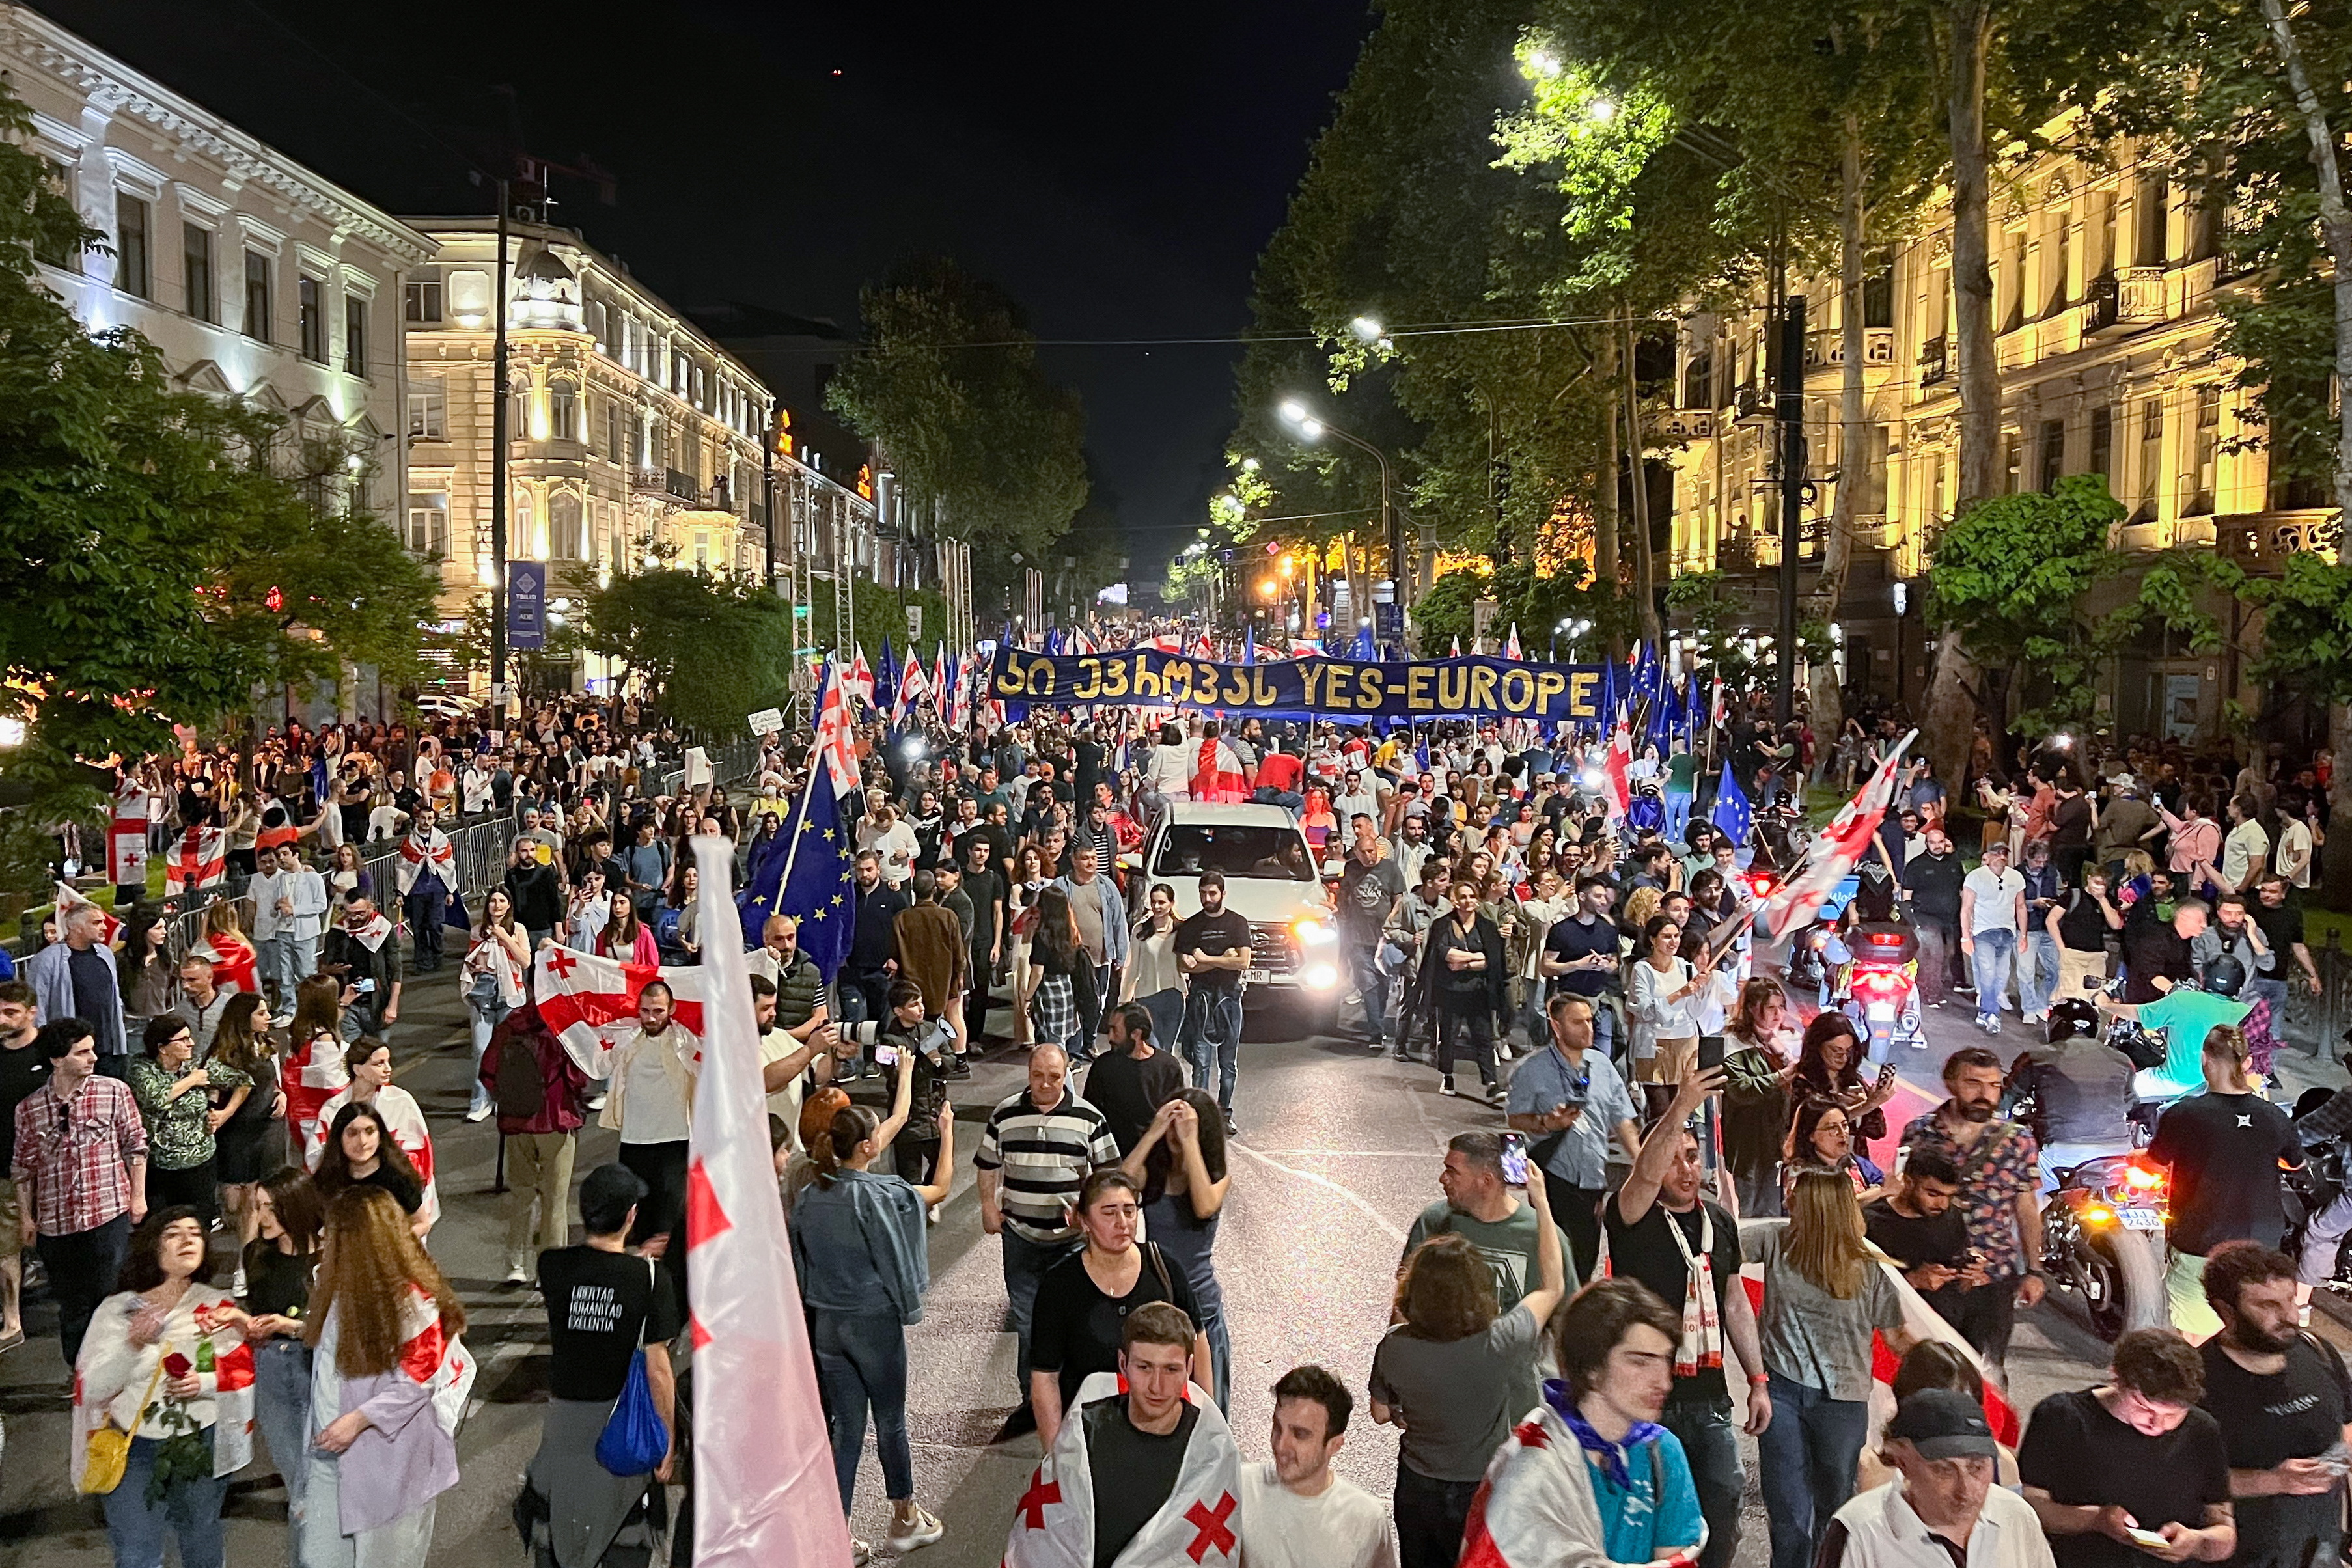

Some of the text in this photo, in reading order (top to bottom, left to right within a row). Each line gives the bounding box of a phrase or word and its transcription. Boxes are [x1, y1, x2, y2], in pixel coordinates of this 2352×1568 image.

[997, 652, 1599, 717] კი ევროპას YES-EUROPE
[572, 1286, 615, 1302] LIBERTAS
[570, 1301, 623, 1319] HUMANITAS
